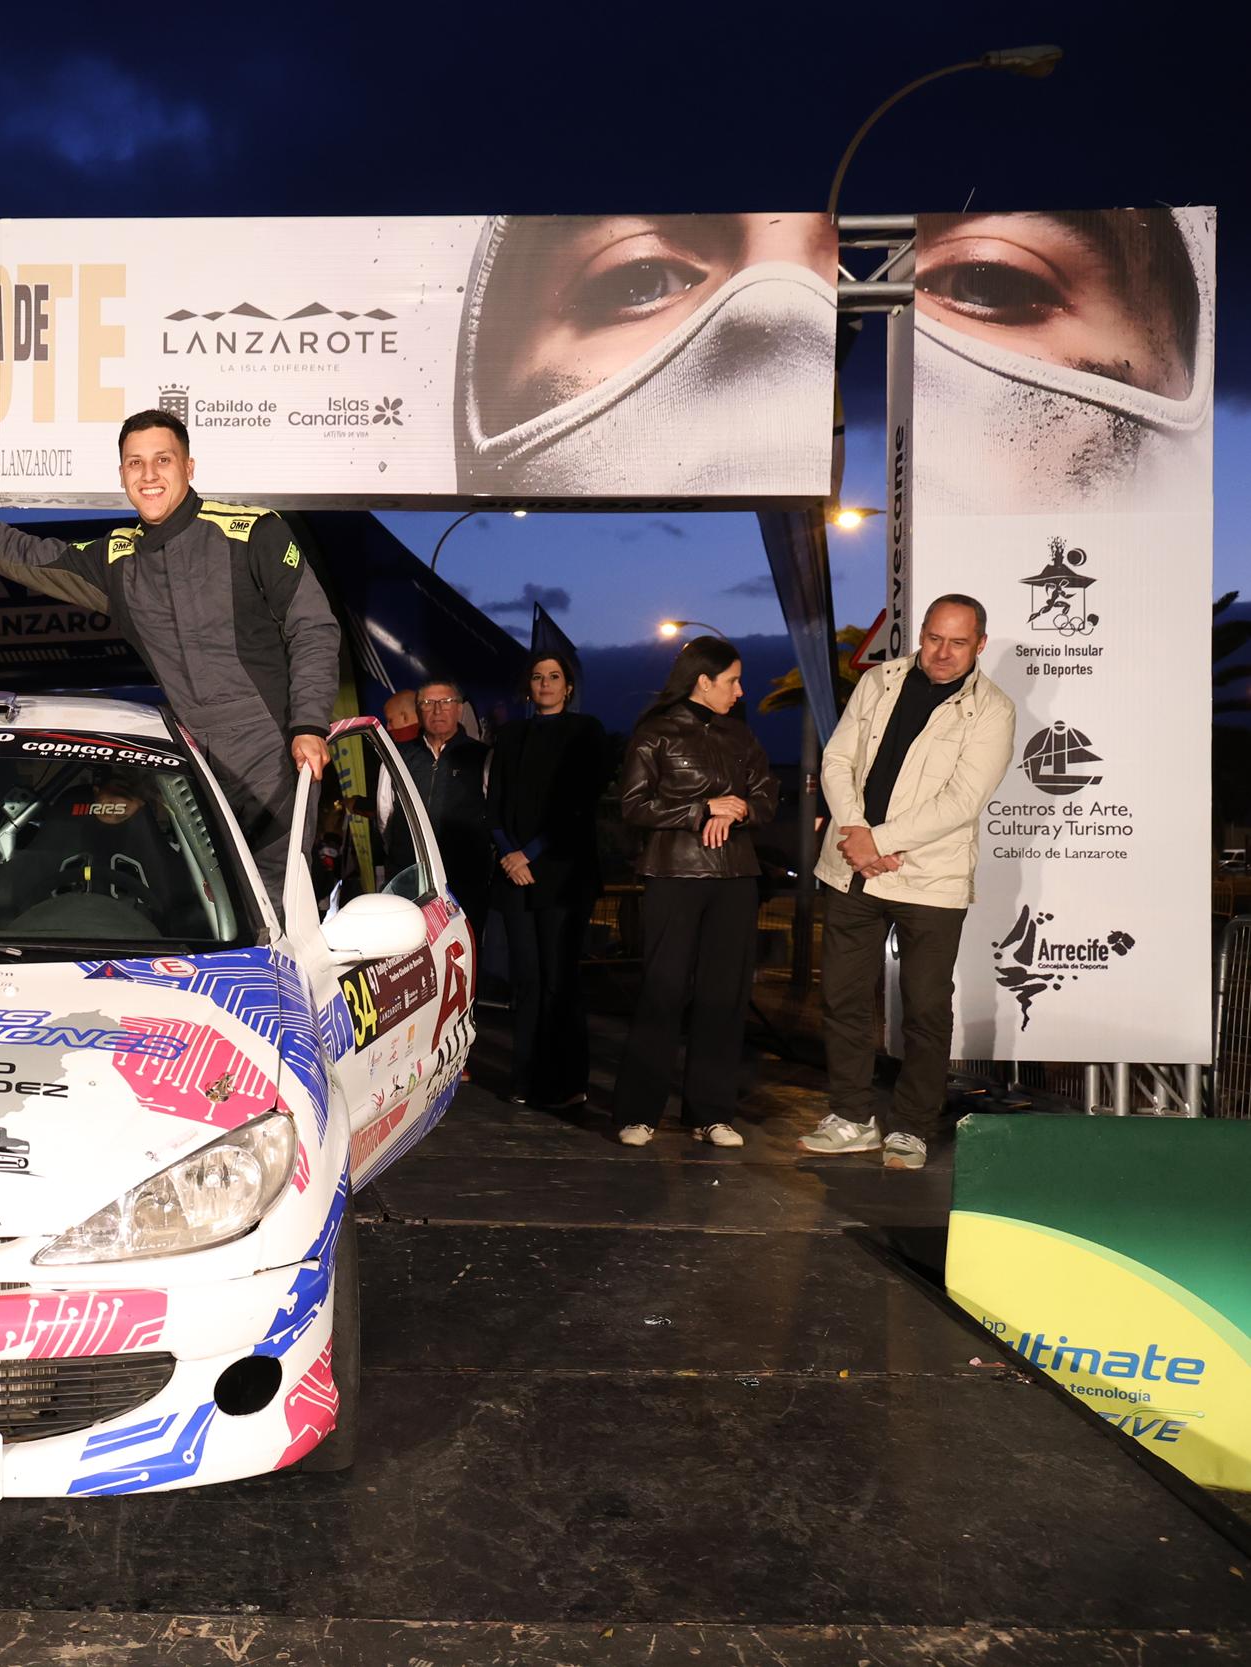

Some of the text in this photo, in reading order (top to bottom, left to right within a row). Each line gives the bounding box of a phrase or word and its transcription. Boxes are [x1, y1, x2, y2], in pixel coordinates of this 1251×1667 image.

[14, 283, 49, 361] DE
[163, 331, 398, 354] LANZAROTE
[220, 364, 341, 372] LA ISLA DIFERENTE
[195, 400, 277, 412] Cabildo de
[328, 397, 370, 411] Islas
[195, 415, 272, 427] Lanzarote
[288, 411, 370, 426] Canarias
[1, 450, 72, 476] LANZAROTE
[230, 521, 249, 531] OMP
[113, 541, 132, 551] OMP
[890, 425, 905, 658] Orvecame
[1015, 644, 1104, 657] Servicio Insular
[1026, 663, 1093, 678] de Deportes
[22, 741, 180, 767] CODIGO CERO
[39, 751, 160, 767] MOTORSPORT
[987, 801, 1133, 818] Centros de Arte,
[987, 820, 1133, 840] Cultura y Turismo
[993, 847, 1127, 859] Cabildo de Lanzarote
[1038, 938, 1109, 961] Arrecife
[344, 971, 378, 1046] 34
[982, 1317, 1007, 1334] bp
[1070, 1383, 1151, 1404] tecnología
